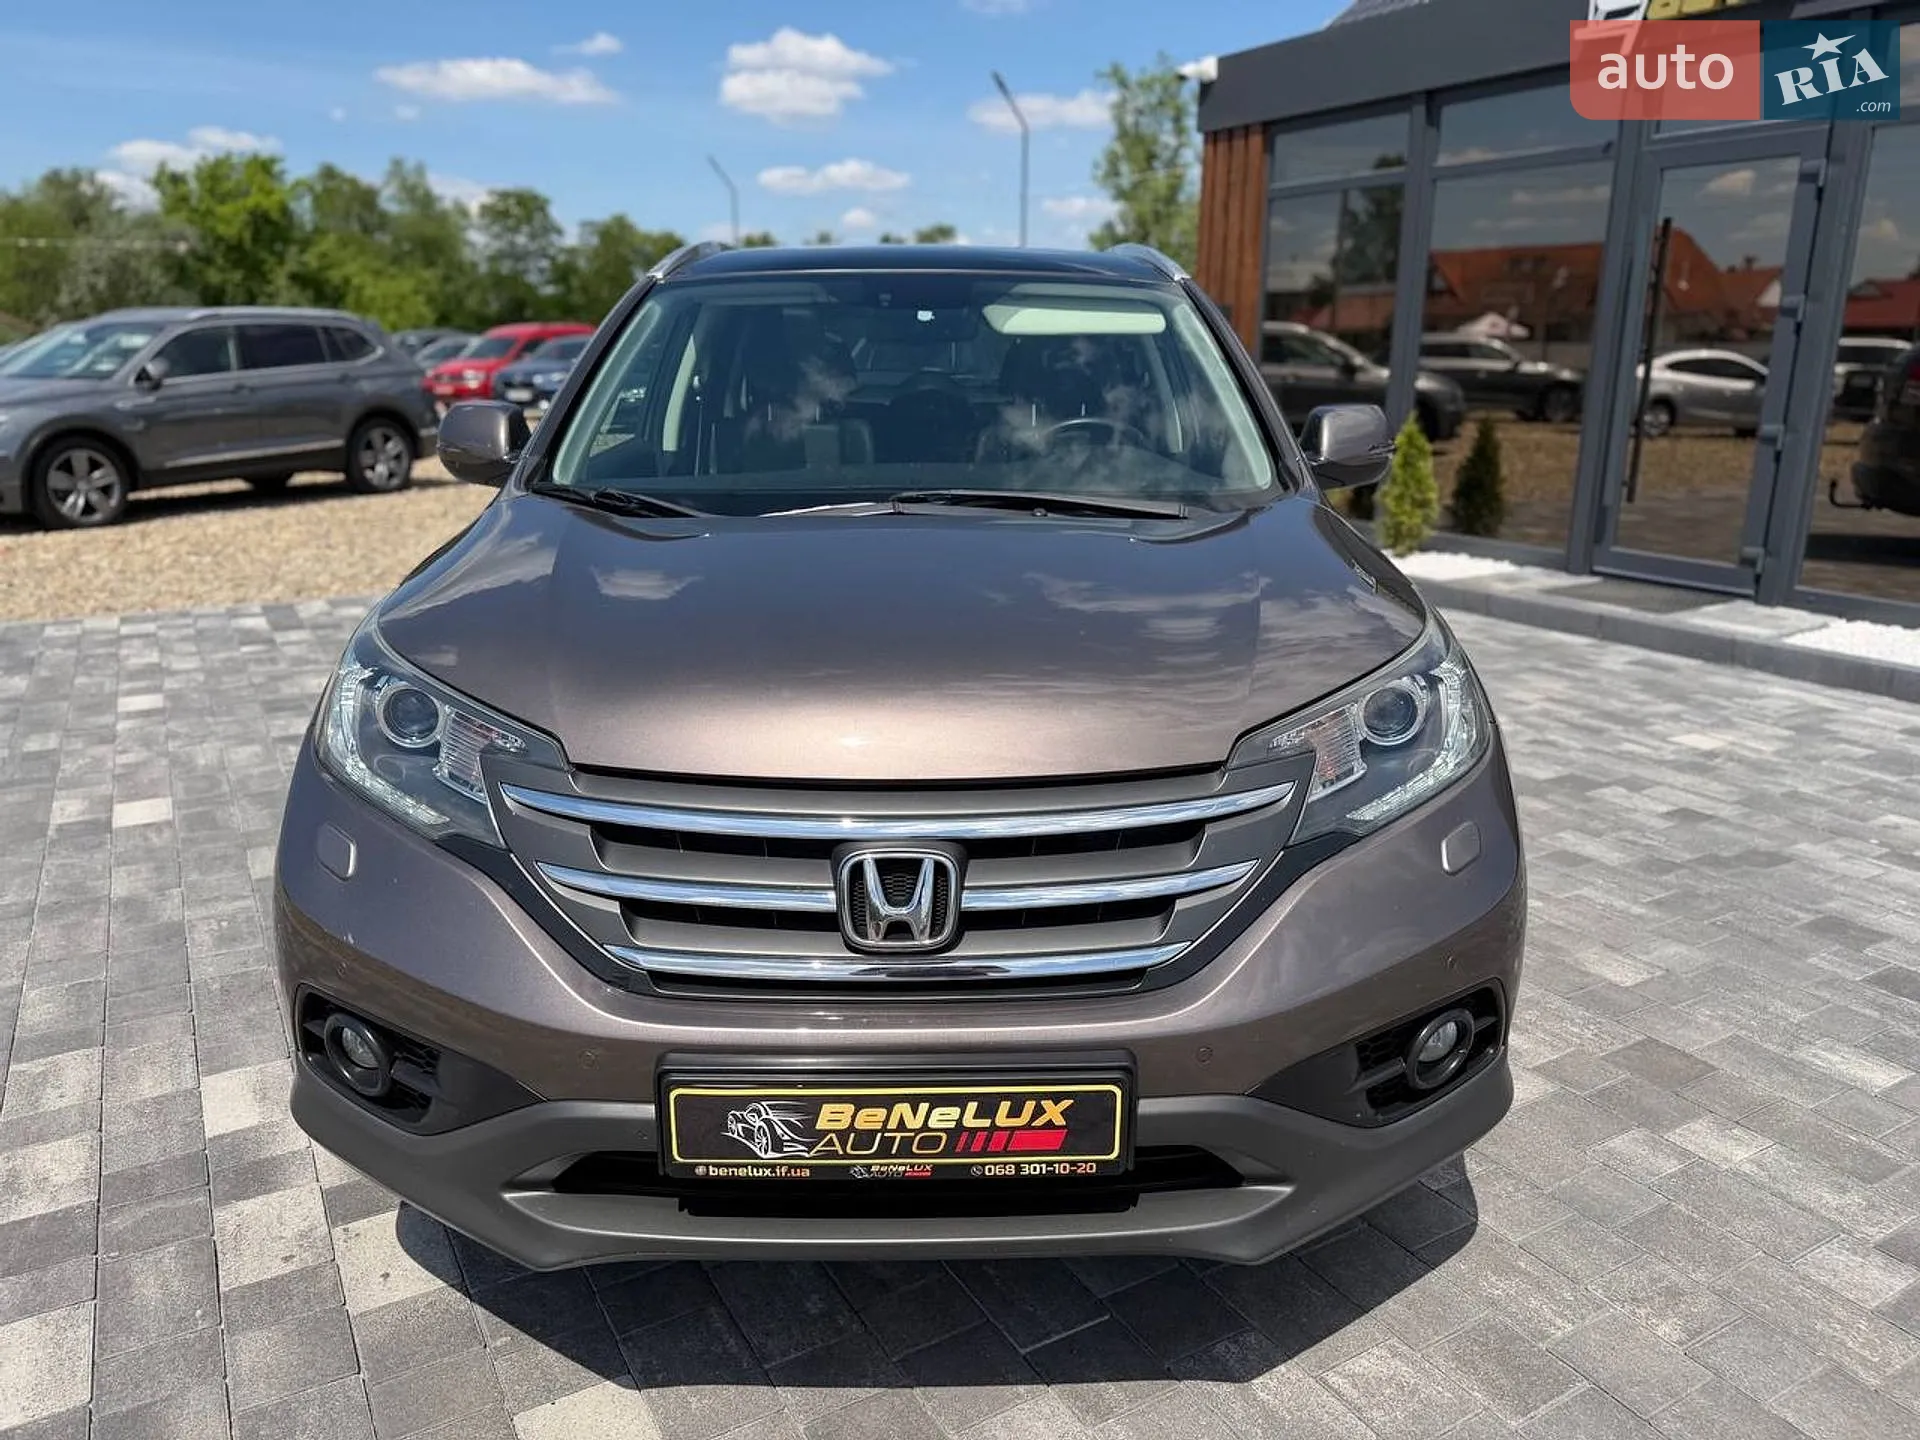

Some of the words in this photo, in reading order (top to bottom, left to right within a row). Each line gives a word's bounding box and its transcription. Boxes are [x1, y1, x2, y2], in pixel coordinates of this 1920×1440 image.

[815, 1099, 1074, 1130] BeNeLUX
[809, 1132, 948, 1156] AUTO
[708, 1165, 811, 1178] benelux.if.ua
[984, 1164, 1016, 1176] 068
[1019, 1162, 1097, 1175] 301-10-20
